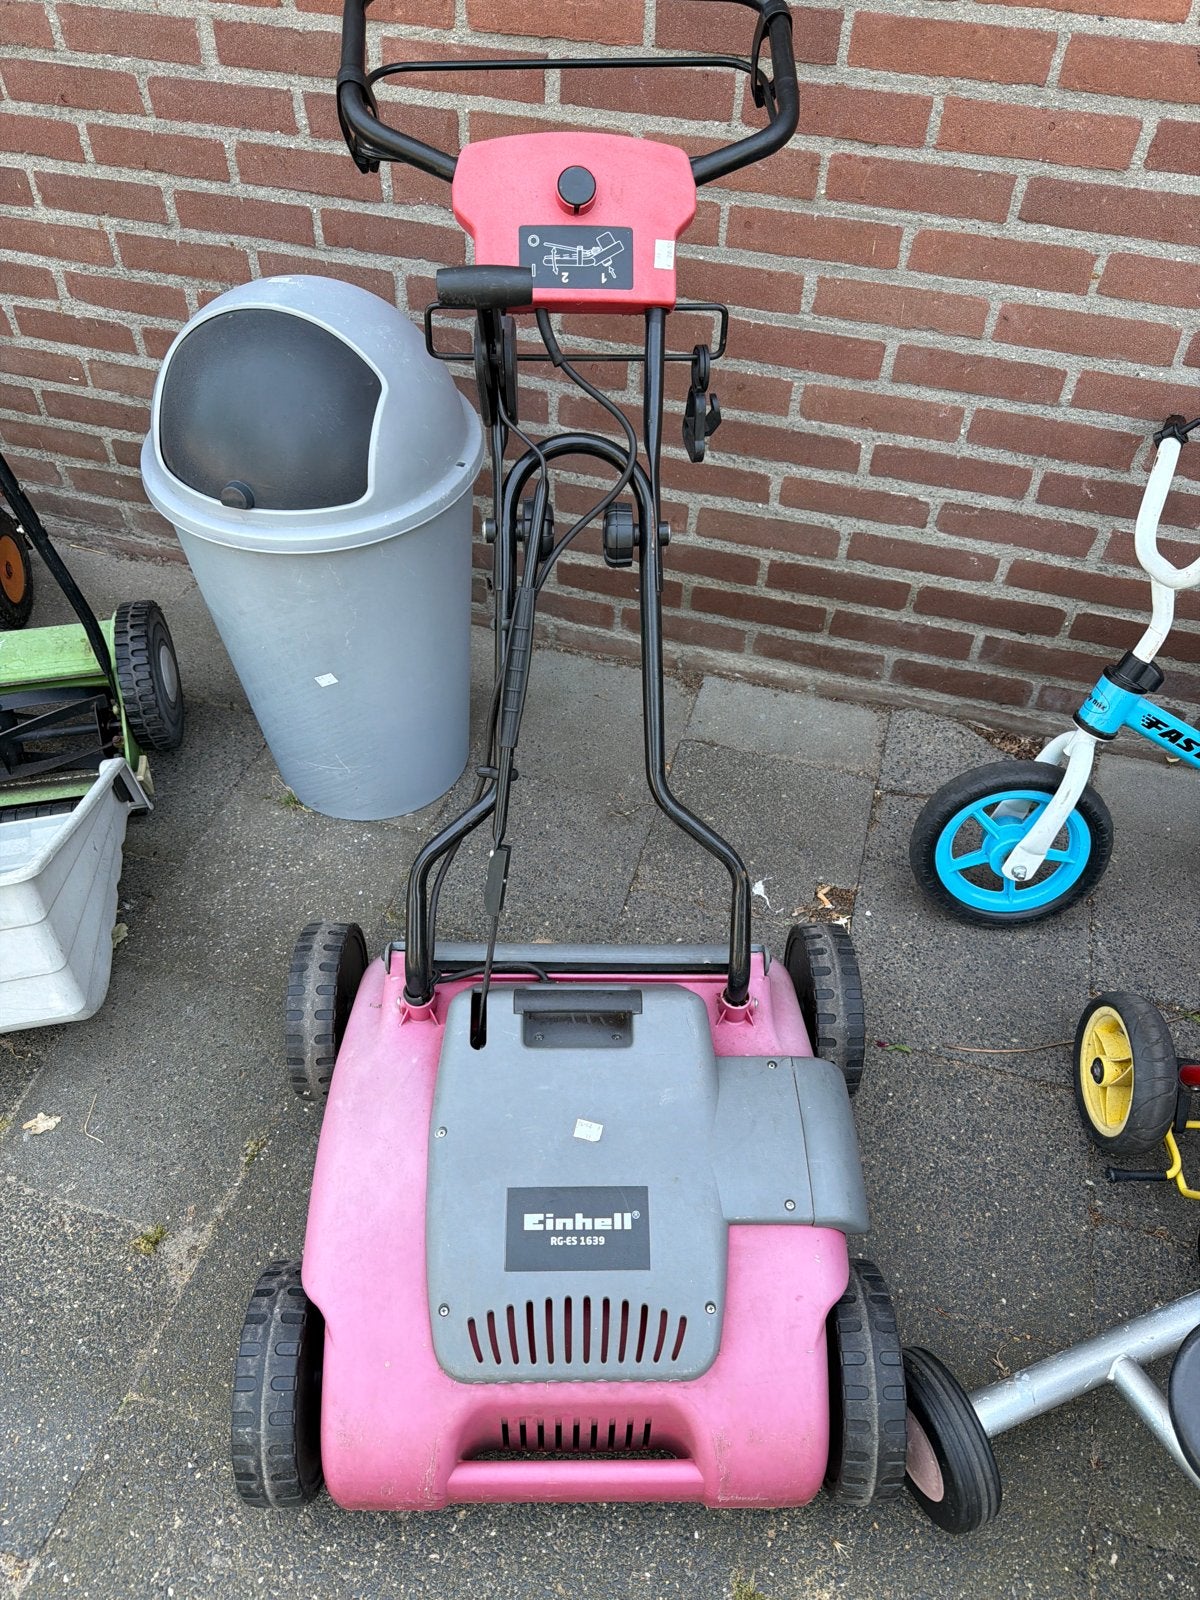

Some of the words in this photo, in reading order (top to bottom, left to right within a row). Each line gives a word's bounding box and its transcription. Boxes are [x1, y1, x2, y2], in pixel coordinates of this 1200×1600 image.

[561, 271, 570, 283] 2
[601, 272, 608, 284] 1
[1141, 714, 1200, 759] FAS
[550, 1236, 578, 1246] RG-ES
[580, 1236, 606, 1246] 1639
